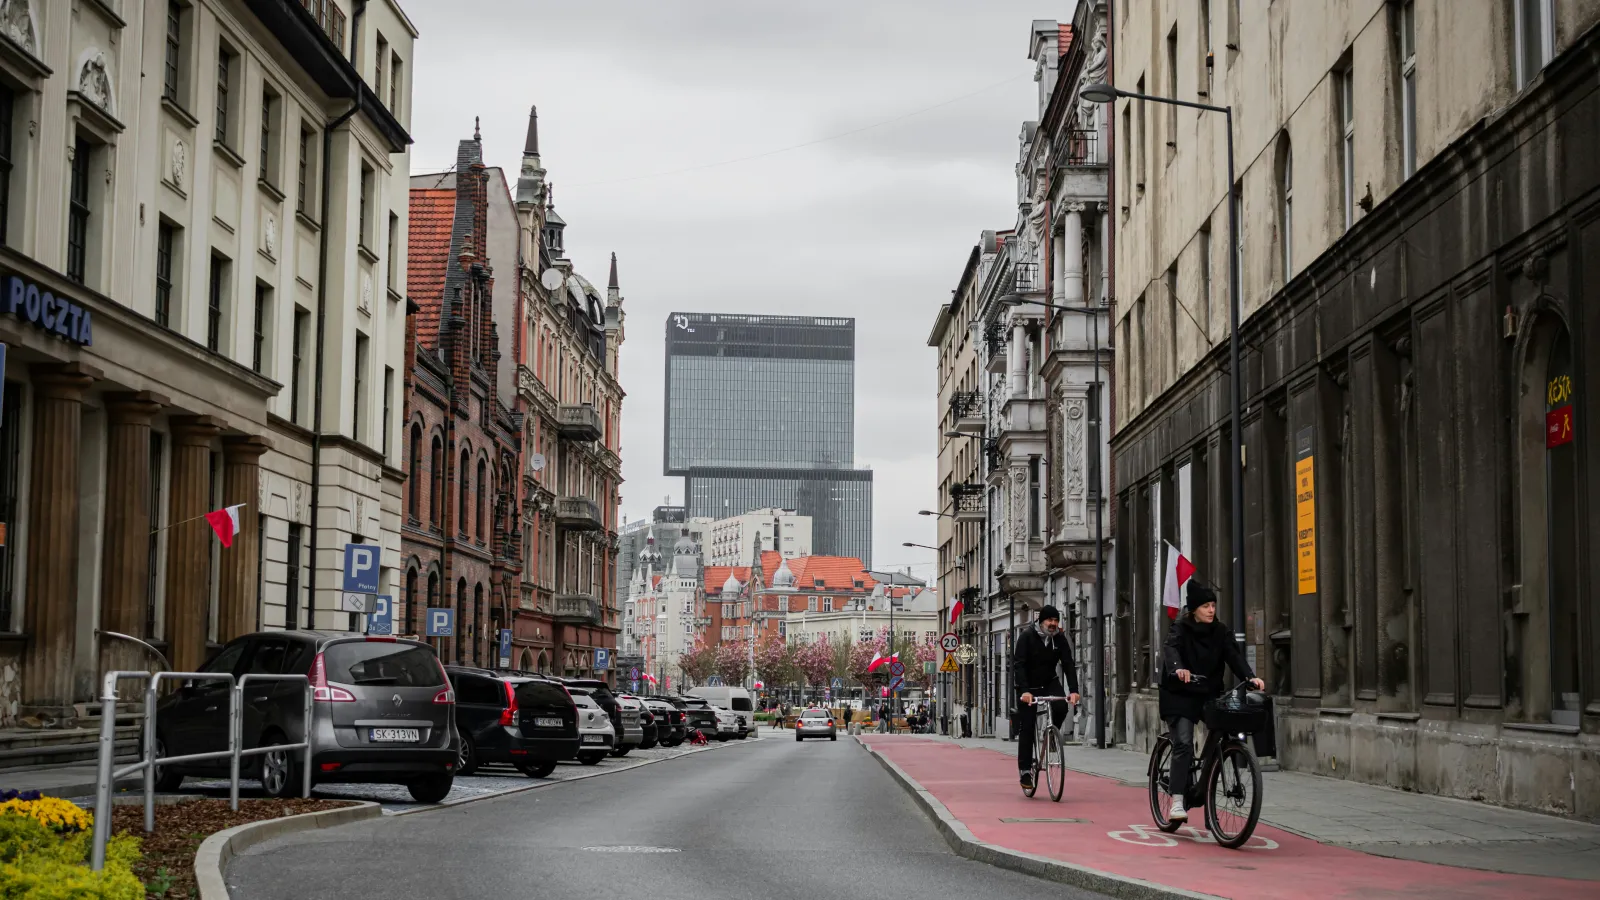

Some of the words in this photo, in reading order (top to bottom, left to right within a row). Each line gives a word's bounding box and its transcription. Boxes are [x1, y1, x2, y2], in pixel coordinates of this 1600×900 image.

[10, 276, 93, 346] POCZTA
[351, 548, 373, 578] P
[372, 598, 388, 622] P
[432, 611, 449, 633] P
[502, 632, 510, 650] P
[943, 638, 958, 648] 20
[597, 650, 606, 663] P
[375, 729, 388, 739] SK
[391, 729, 418, 740] 313VN
